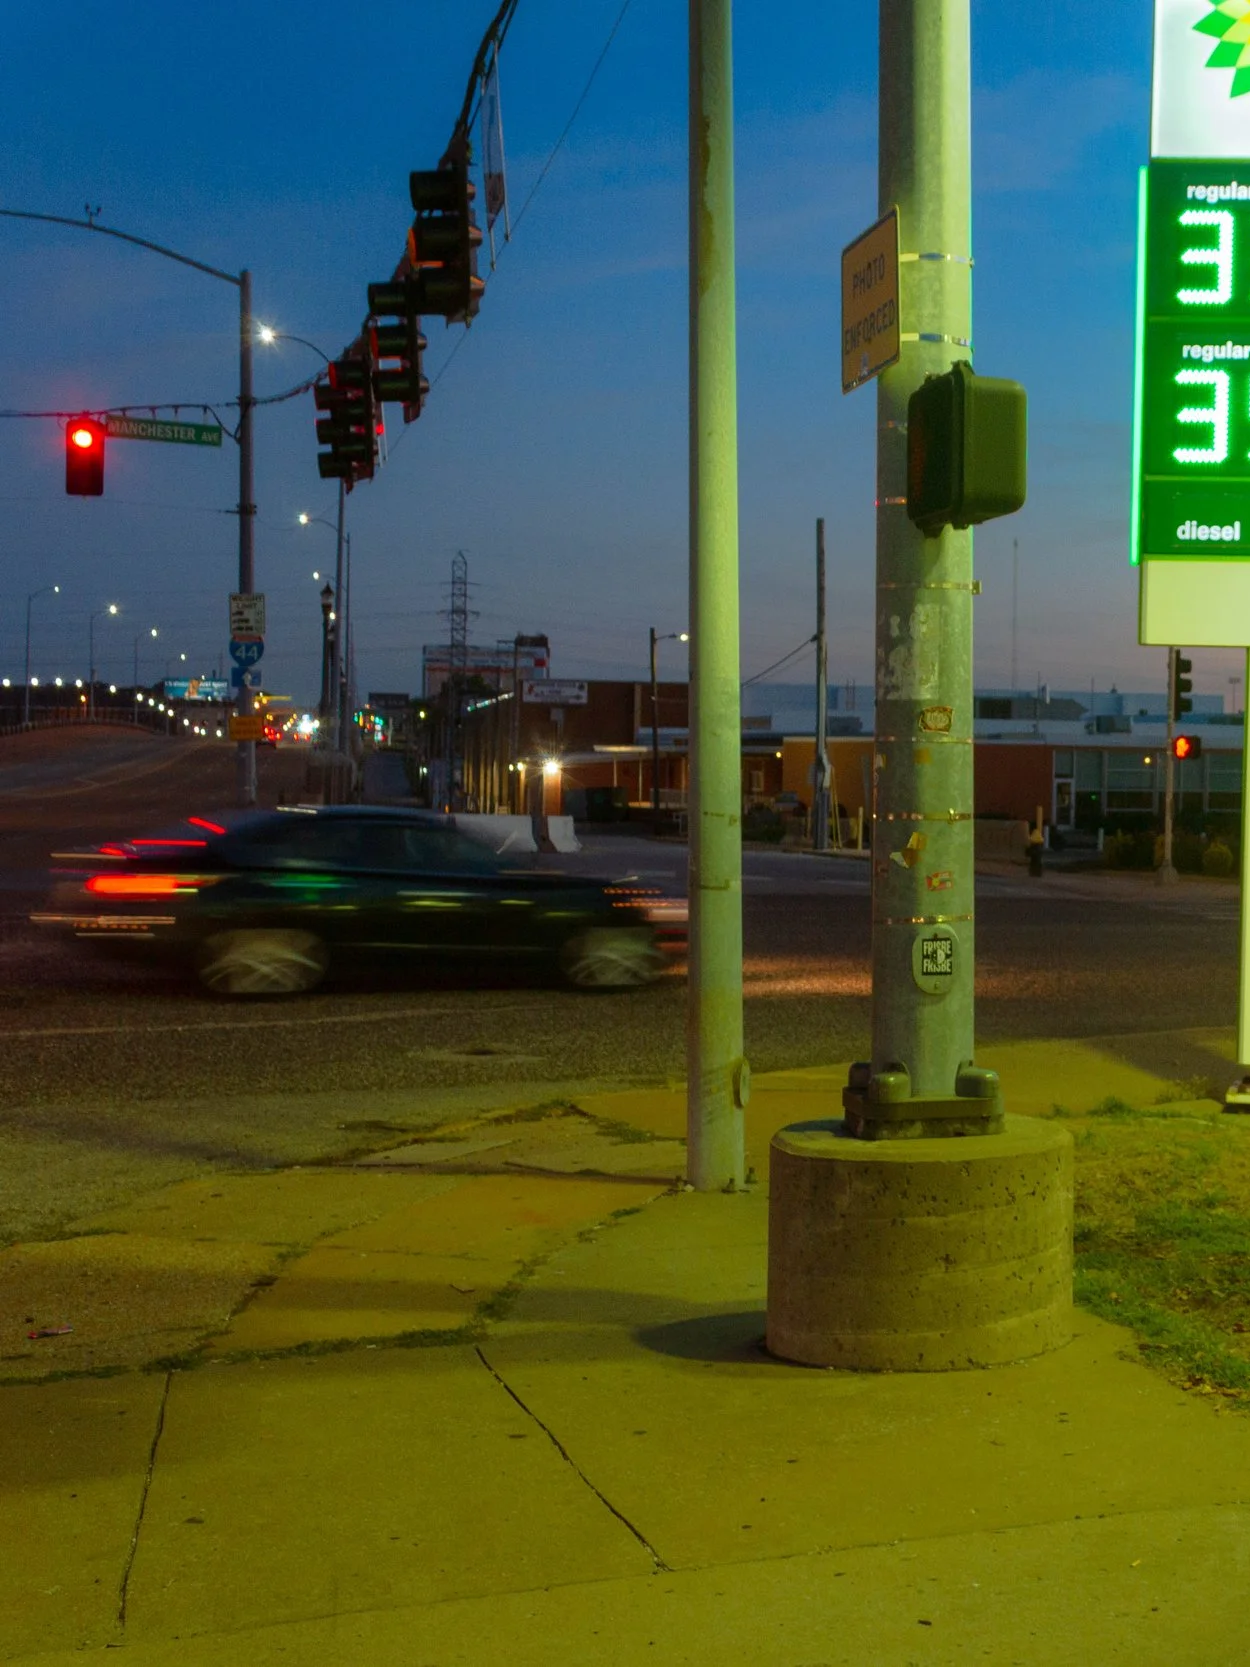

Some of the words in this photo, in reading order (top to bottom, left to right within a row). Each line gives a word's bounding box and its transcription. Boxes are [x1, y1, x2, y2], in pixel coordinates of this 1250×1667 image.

[853, 254, 886, 299] PHOTO
[844, 300, 896, 356] ENFORCED
[107, 421, 196, 441] MANCHESTER
[201, 431, 220, 443] AVE
[1176, 521, 1241, 541] diesel
[234, 644, 259, 661] 44
